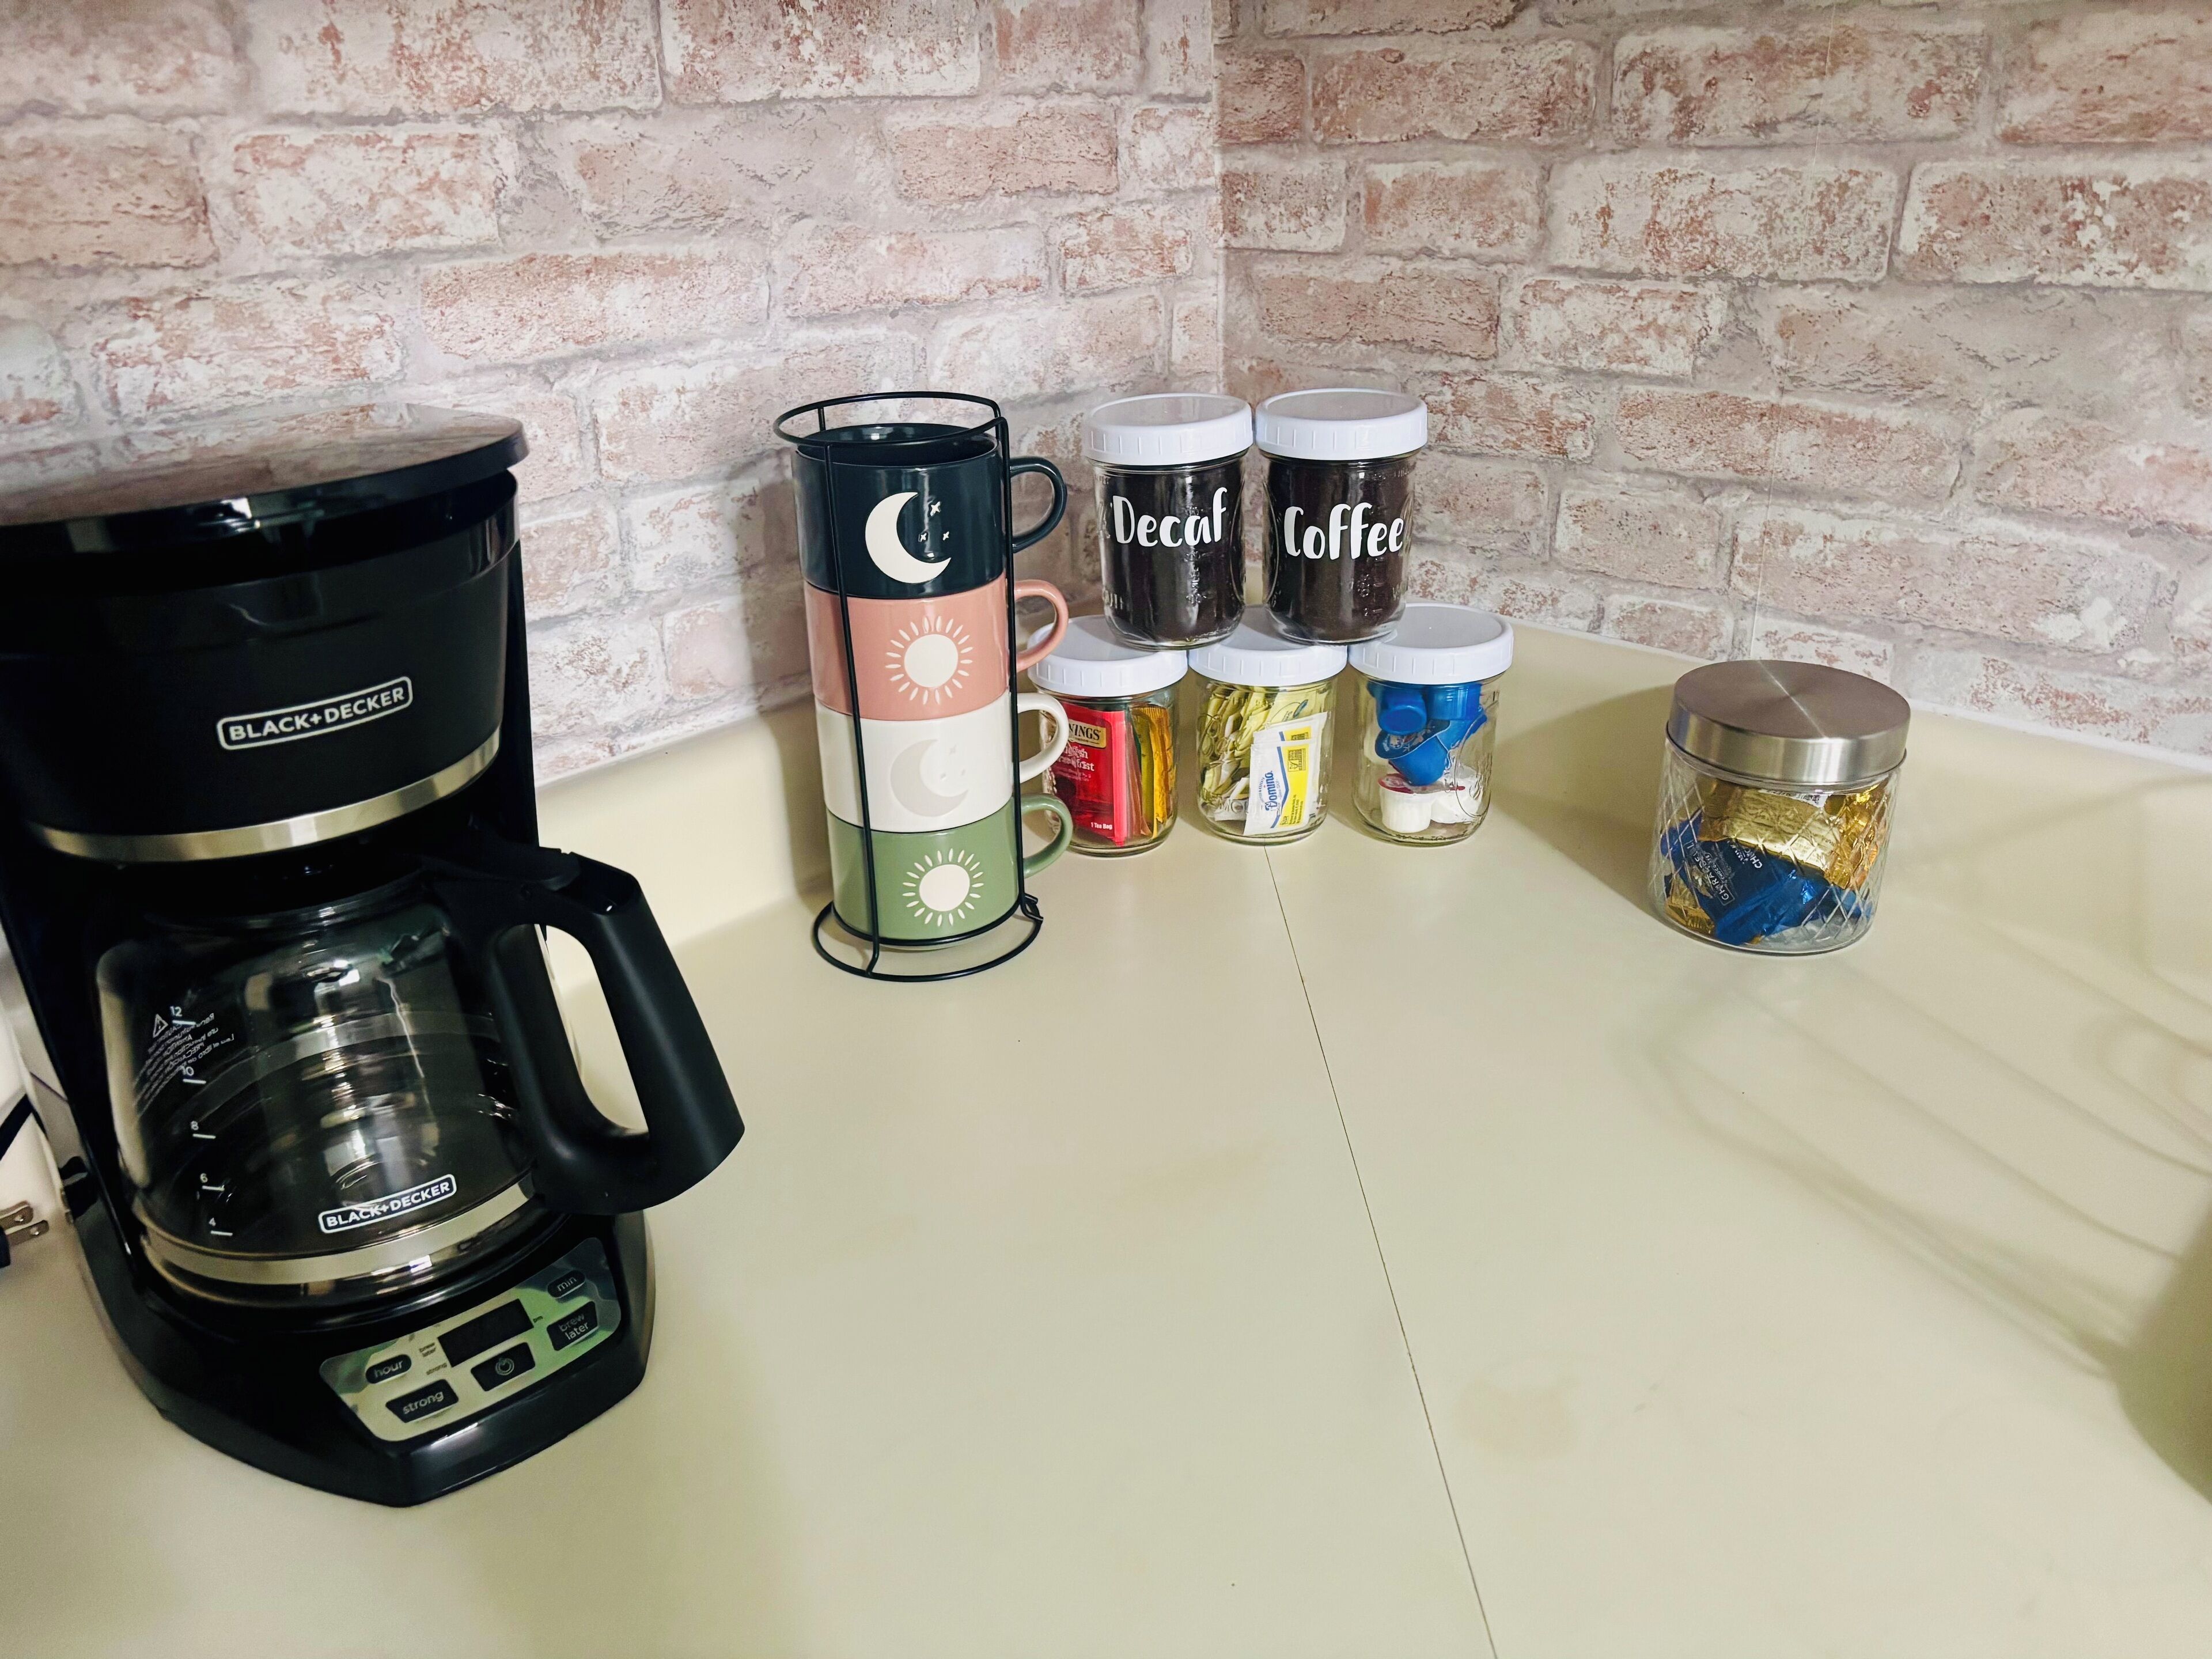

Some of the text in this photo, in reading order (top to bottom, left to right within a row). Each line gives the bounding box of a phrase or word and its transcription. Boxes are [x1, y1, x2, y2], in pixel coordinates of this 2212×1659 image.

[1112, 487, 1228, 547] Decaf
[1284, 502, 1404, 560] Coffee
[229, 687, 404, 741] BLACK+DECKER
[1264, 771, 1278, 811] Domino
[170, 1006, 183, 1017] 12
[181, 1066, 195, 1076] 10
[191, 1121, 199, 1131] 8
[200, 1173, 208, 1183] 6
[327, 1181, 450, 1227] BLACK+DECKER
[209, 1217, 216, 1227] 4
[558, 1276, 577, 1292] min
[559, 1312, 585, 1332] brew
[566, 1321, 589, 1340] later
[374, 1361, 403, 1378] hour
[403, 1390, 444, 1415] strong
